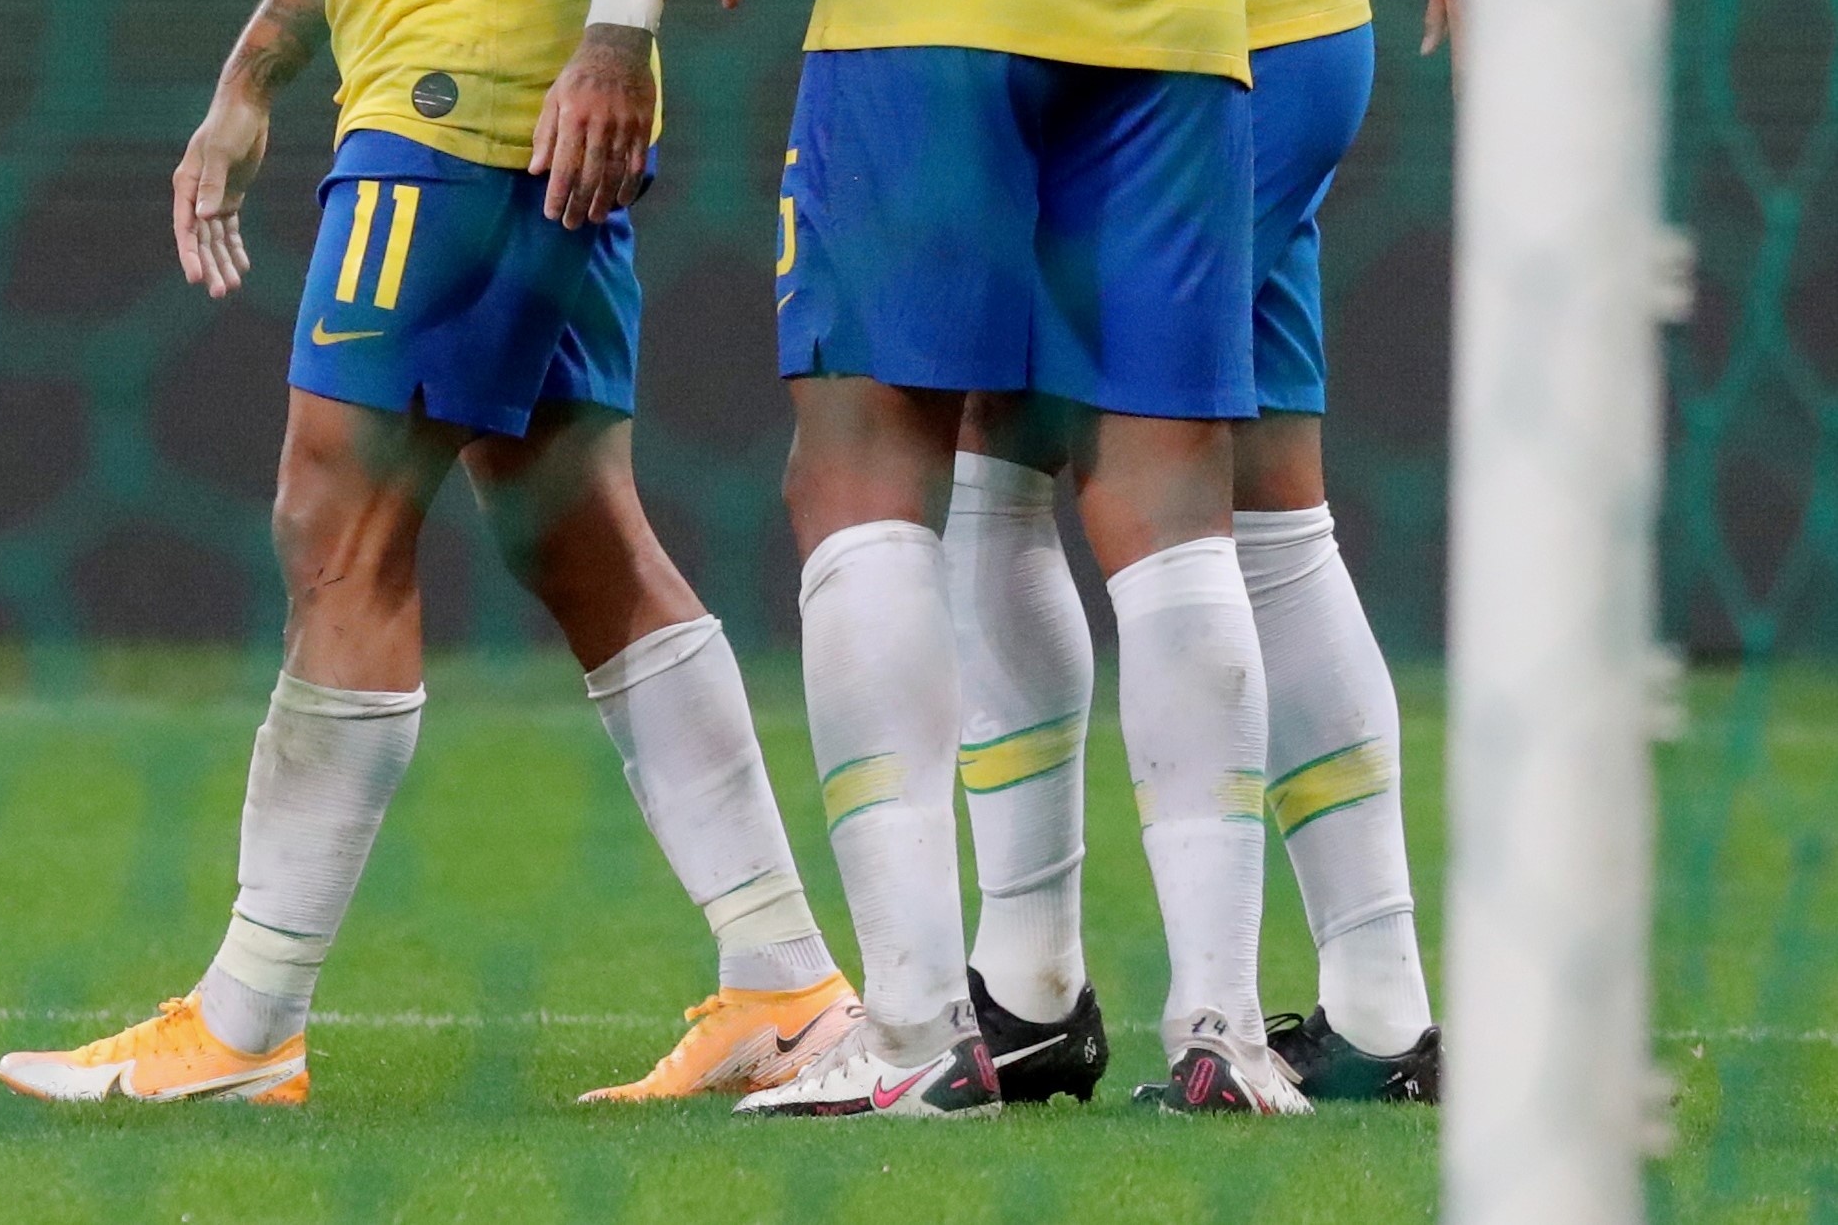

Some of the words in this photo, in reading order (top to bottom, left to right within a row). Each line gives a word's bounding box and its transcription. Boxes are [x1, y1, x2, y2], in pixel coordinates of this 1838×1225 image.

[335, 179, 420, 310] 11
[950, 1004, 976, 1027] 14
[1191, 1016, 1228, 1036] 14
